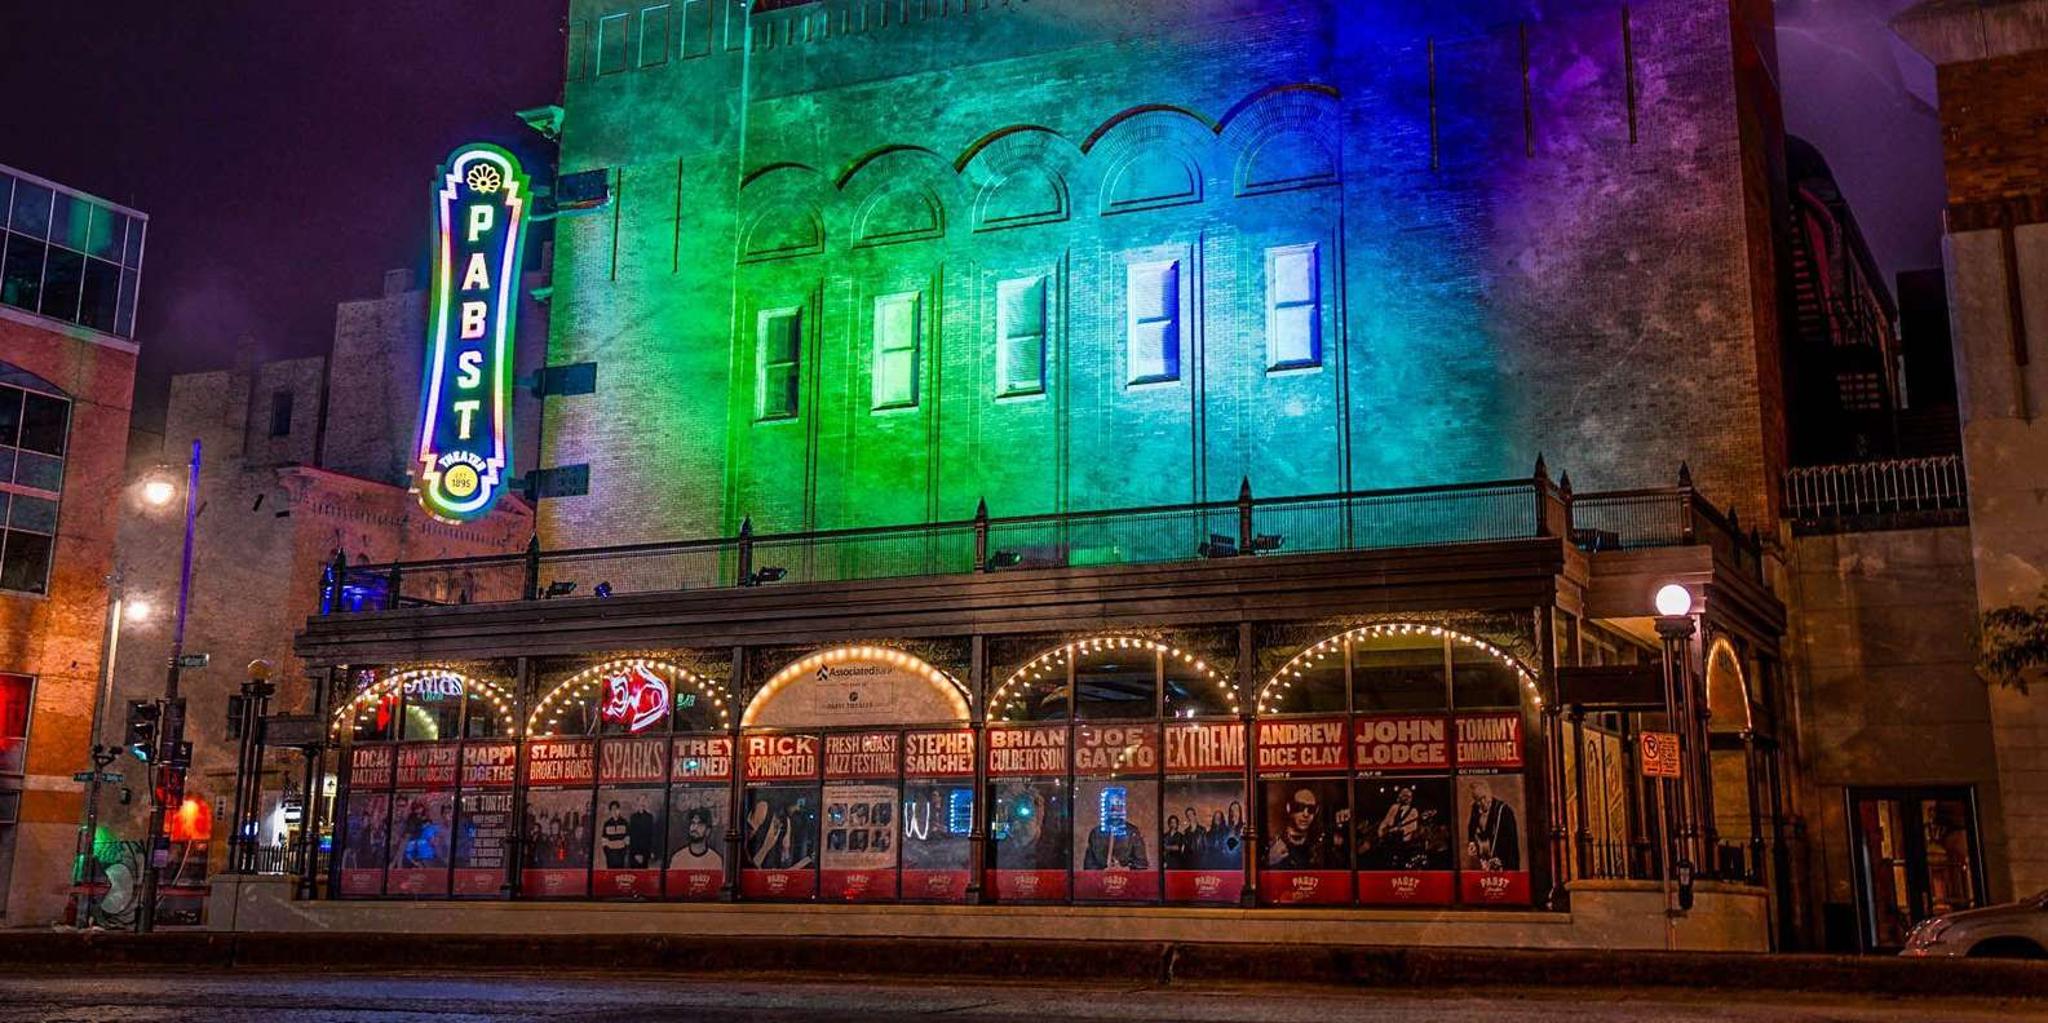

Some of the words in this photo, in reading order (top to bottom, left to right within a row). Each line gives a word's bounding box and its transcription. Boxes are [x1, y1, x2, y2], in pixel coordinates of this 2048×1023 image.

[461, 204, 494, 440] PABST
[438, 450, 487, 472] THEATER
[451, 479, 471, 488] 1895
[990, 730, 1065, 748] BRIAN
[1085, 729, 1144, 746] JOE
[1259, 723, 1343, 745] ANDREW
[1356, 719, 1445, 743] JOHN
[1456, 718, 1518, 742] TOMMY
[531, 745, 547, 760] ST.
[549, 743, 577, 759] PAUL
[580, 744, 588, 758] &
[750, 737, 814, 755] RICK
[826, 736, 860, 754] FRESH
[862, 734, 898, 752] COAST
[1357, 743, 1446, 765] LODGE
[1457, 742, 1520, 762] EMMANUEL
[353, 749, 391, 768] LOCAL
[602, 741, 664, 779] SPARKS
[747, 755, 815, 777] SPRINGFIELD
[826, 754, 850, 773] JAZZ
[851, 753, 896, 773] FESTIVAL
[906, 754, 974, 773] SANCHEZ
[990, 748, 1065, 771] CULBERTSON
[1076, 746, 1155, 769] GATTO
[1260, 747, 1297, 766] DICE
[1300, 746, 1343, 765] CLAY
[351, 768, 391, 785] NATIVES
[530, 760, 564, 779] BROKEN
[564, 759, 593, 778] BONES
